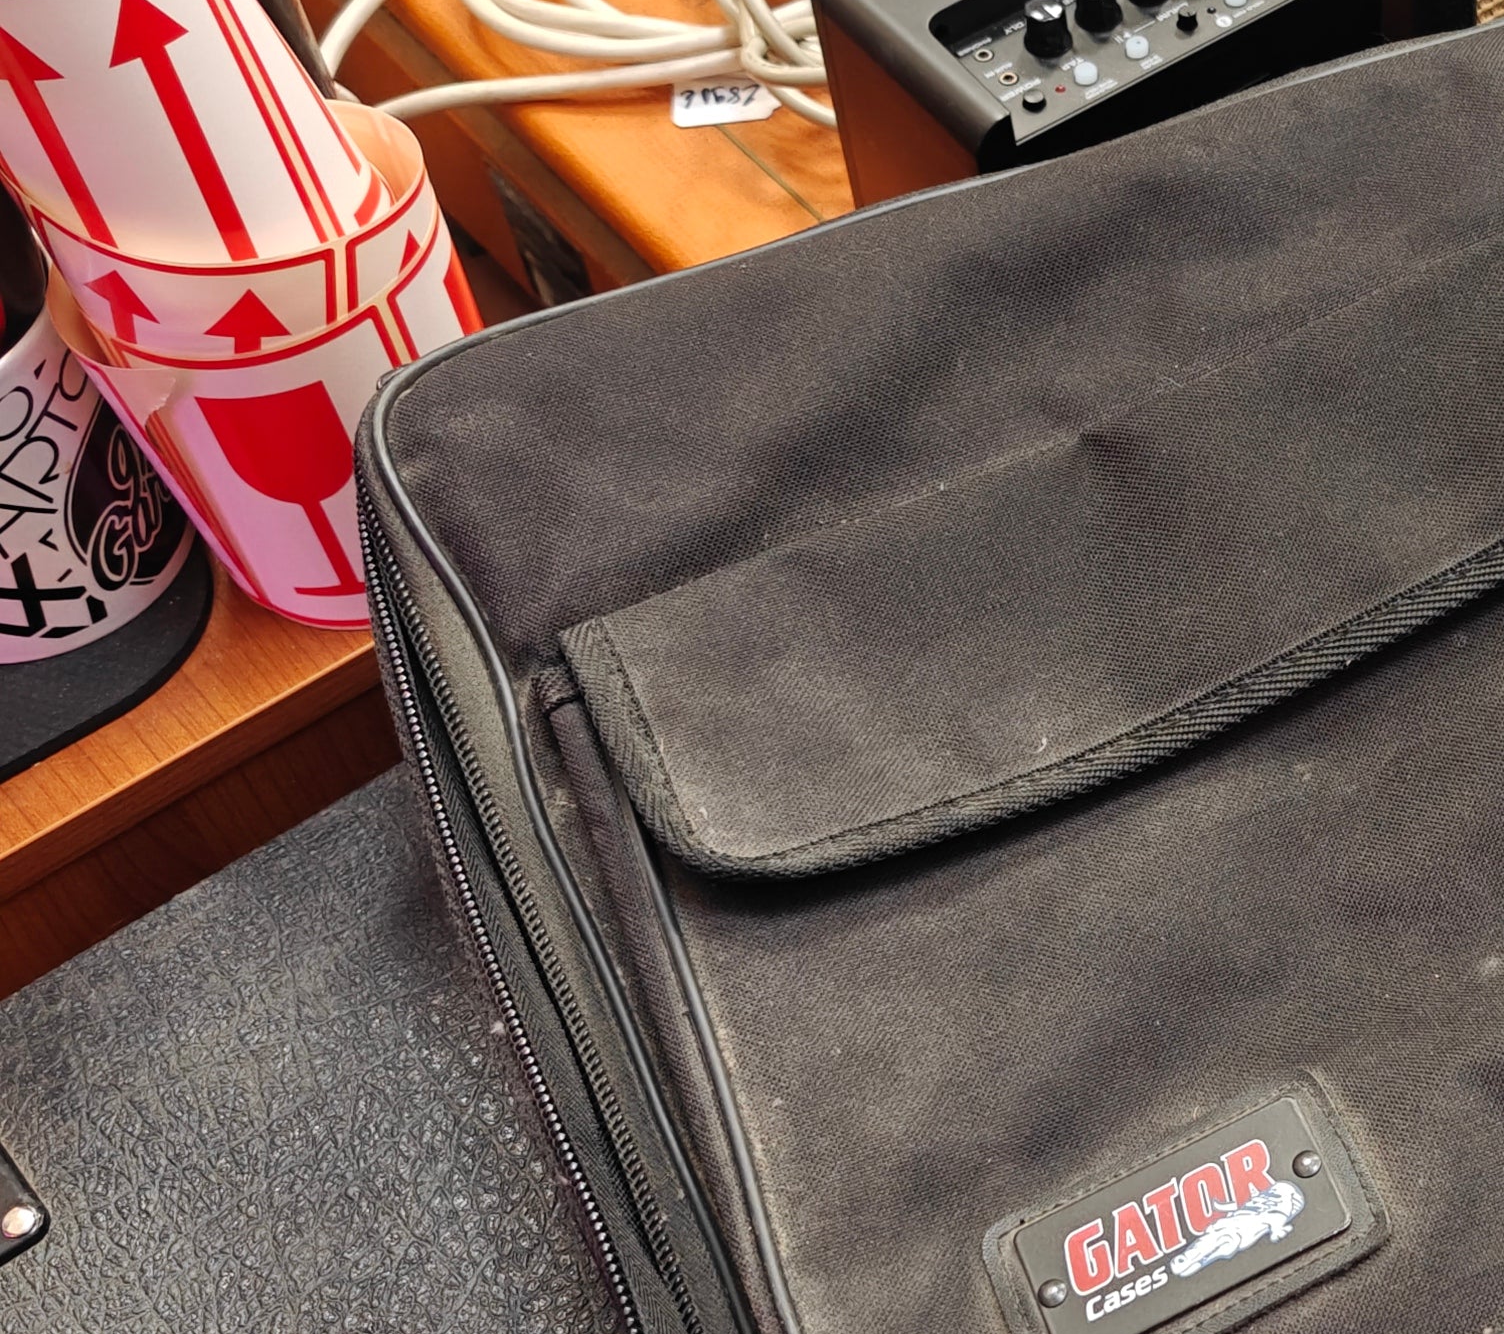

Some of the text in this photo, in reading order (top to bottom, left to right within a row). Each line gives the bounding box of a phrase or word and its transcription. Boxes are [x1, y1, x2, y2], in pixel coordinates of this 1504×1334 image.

[998, 76, 1042, 103] POWER
[1063, 1137, 1277, 1298] GATOR
[1085, 1264, 1170, 1323] Cases
